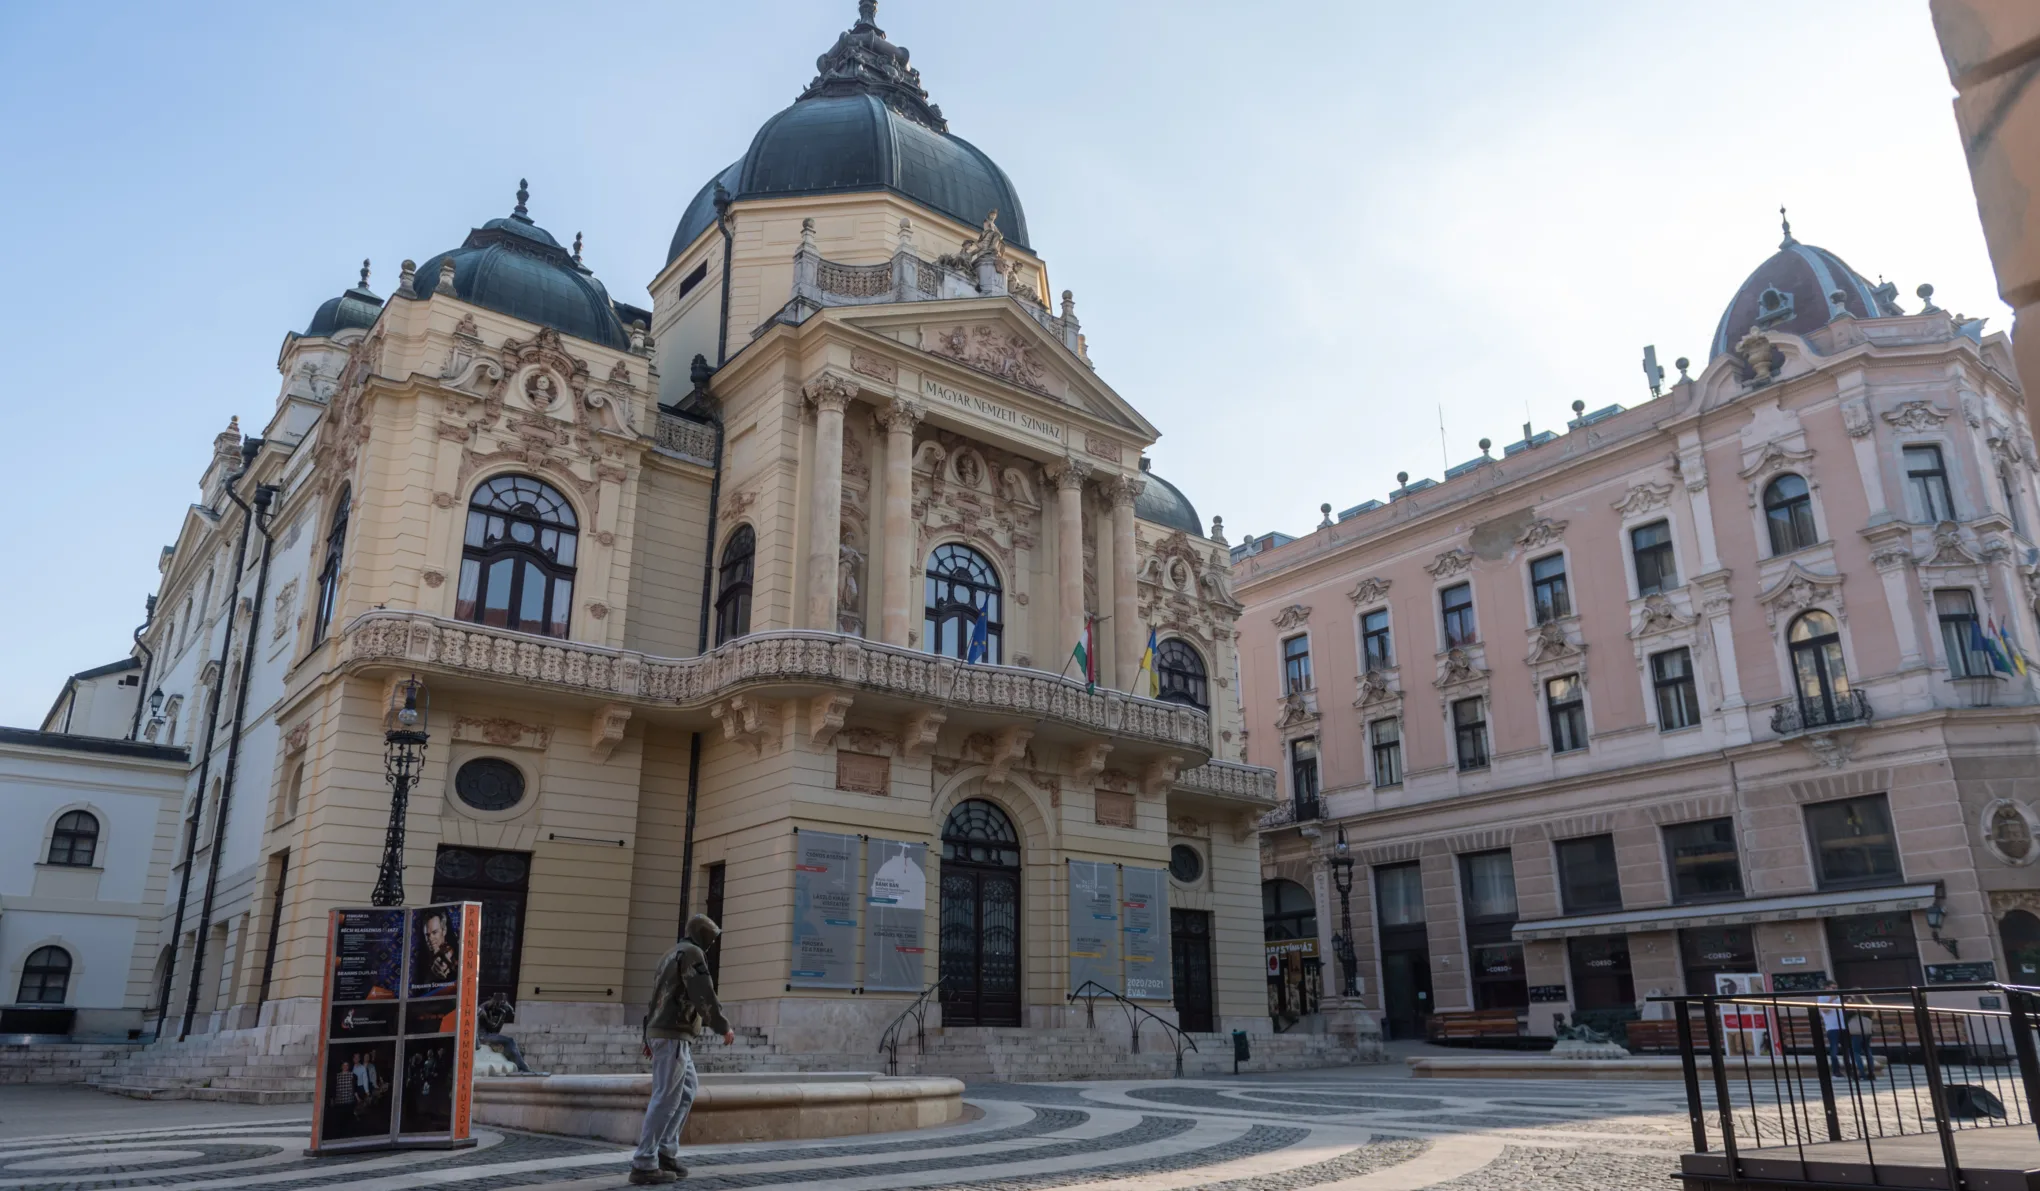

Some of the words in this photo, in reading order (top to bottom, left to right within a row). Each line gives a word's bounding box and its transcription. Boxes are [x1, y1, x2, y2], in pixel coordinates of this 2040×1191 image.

[926, 381, 971, 408] MAGYAR
[974, 398, 1016, 423] NEMZETI
[1021, 414, 1060, 439] SZÍNHÁZ
[467, 908, 475, 969] PANNON
[1859, 940, 1888, 949] CORSO
[1127, 978, 1164, 988] 2020/2021
[1127, 986, 1147, 997] ÉVAD
